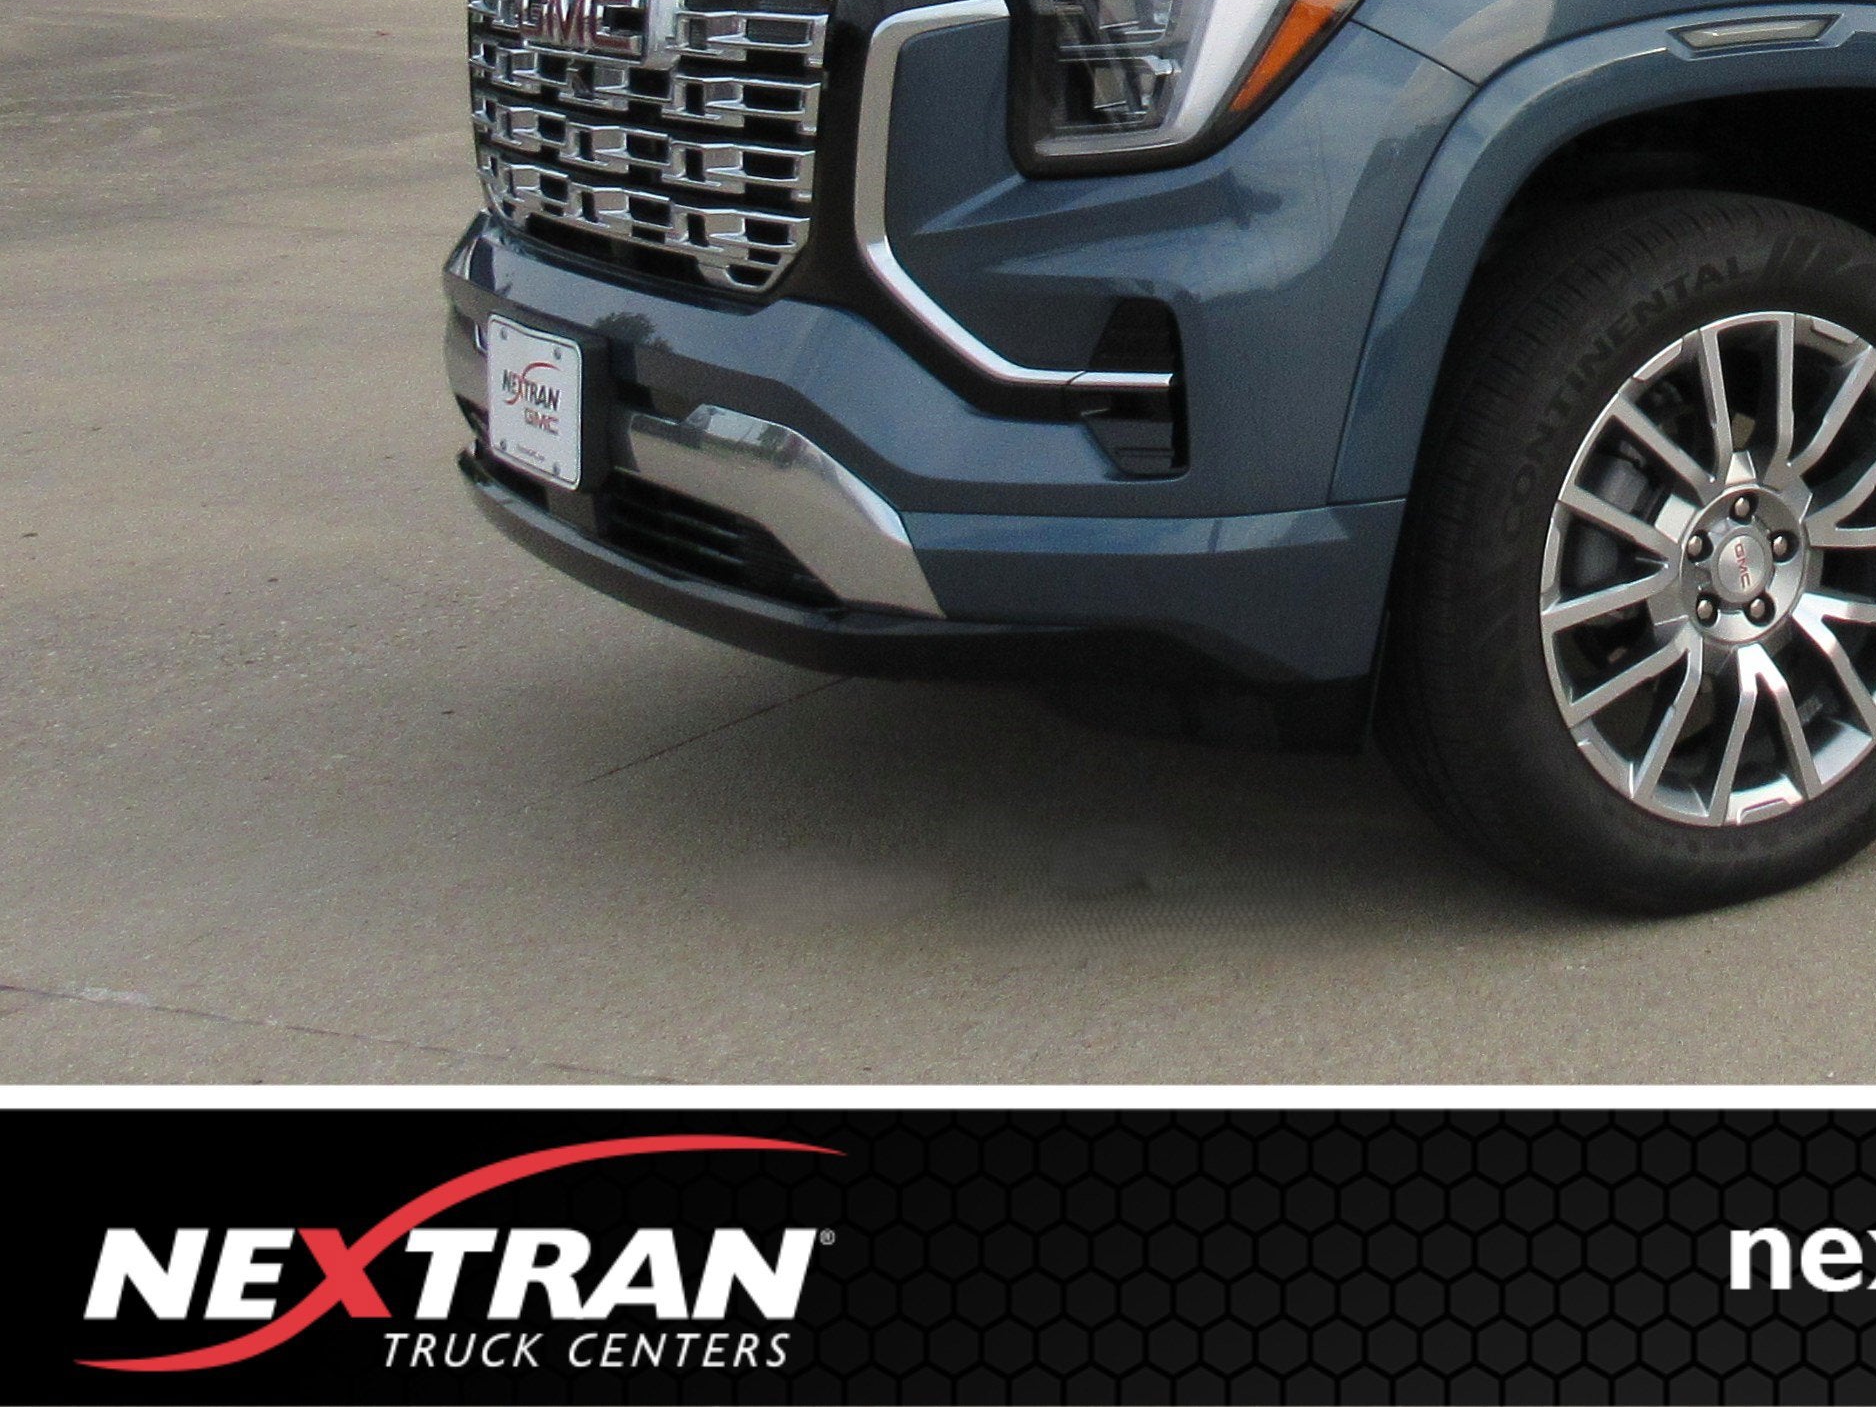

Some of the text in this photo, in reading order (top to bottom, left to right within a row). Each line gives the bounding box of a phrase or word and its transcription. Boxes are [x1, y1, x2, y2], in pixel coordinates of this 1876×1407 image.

[502, 368, 561, 412] NEXTRAN
[1501, 255, 1752, 544] CONTINENTAL
[1733, 542, 1751, 590] GMC
